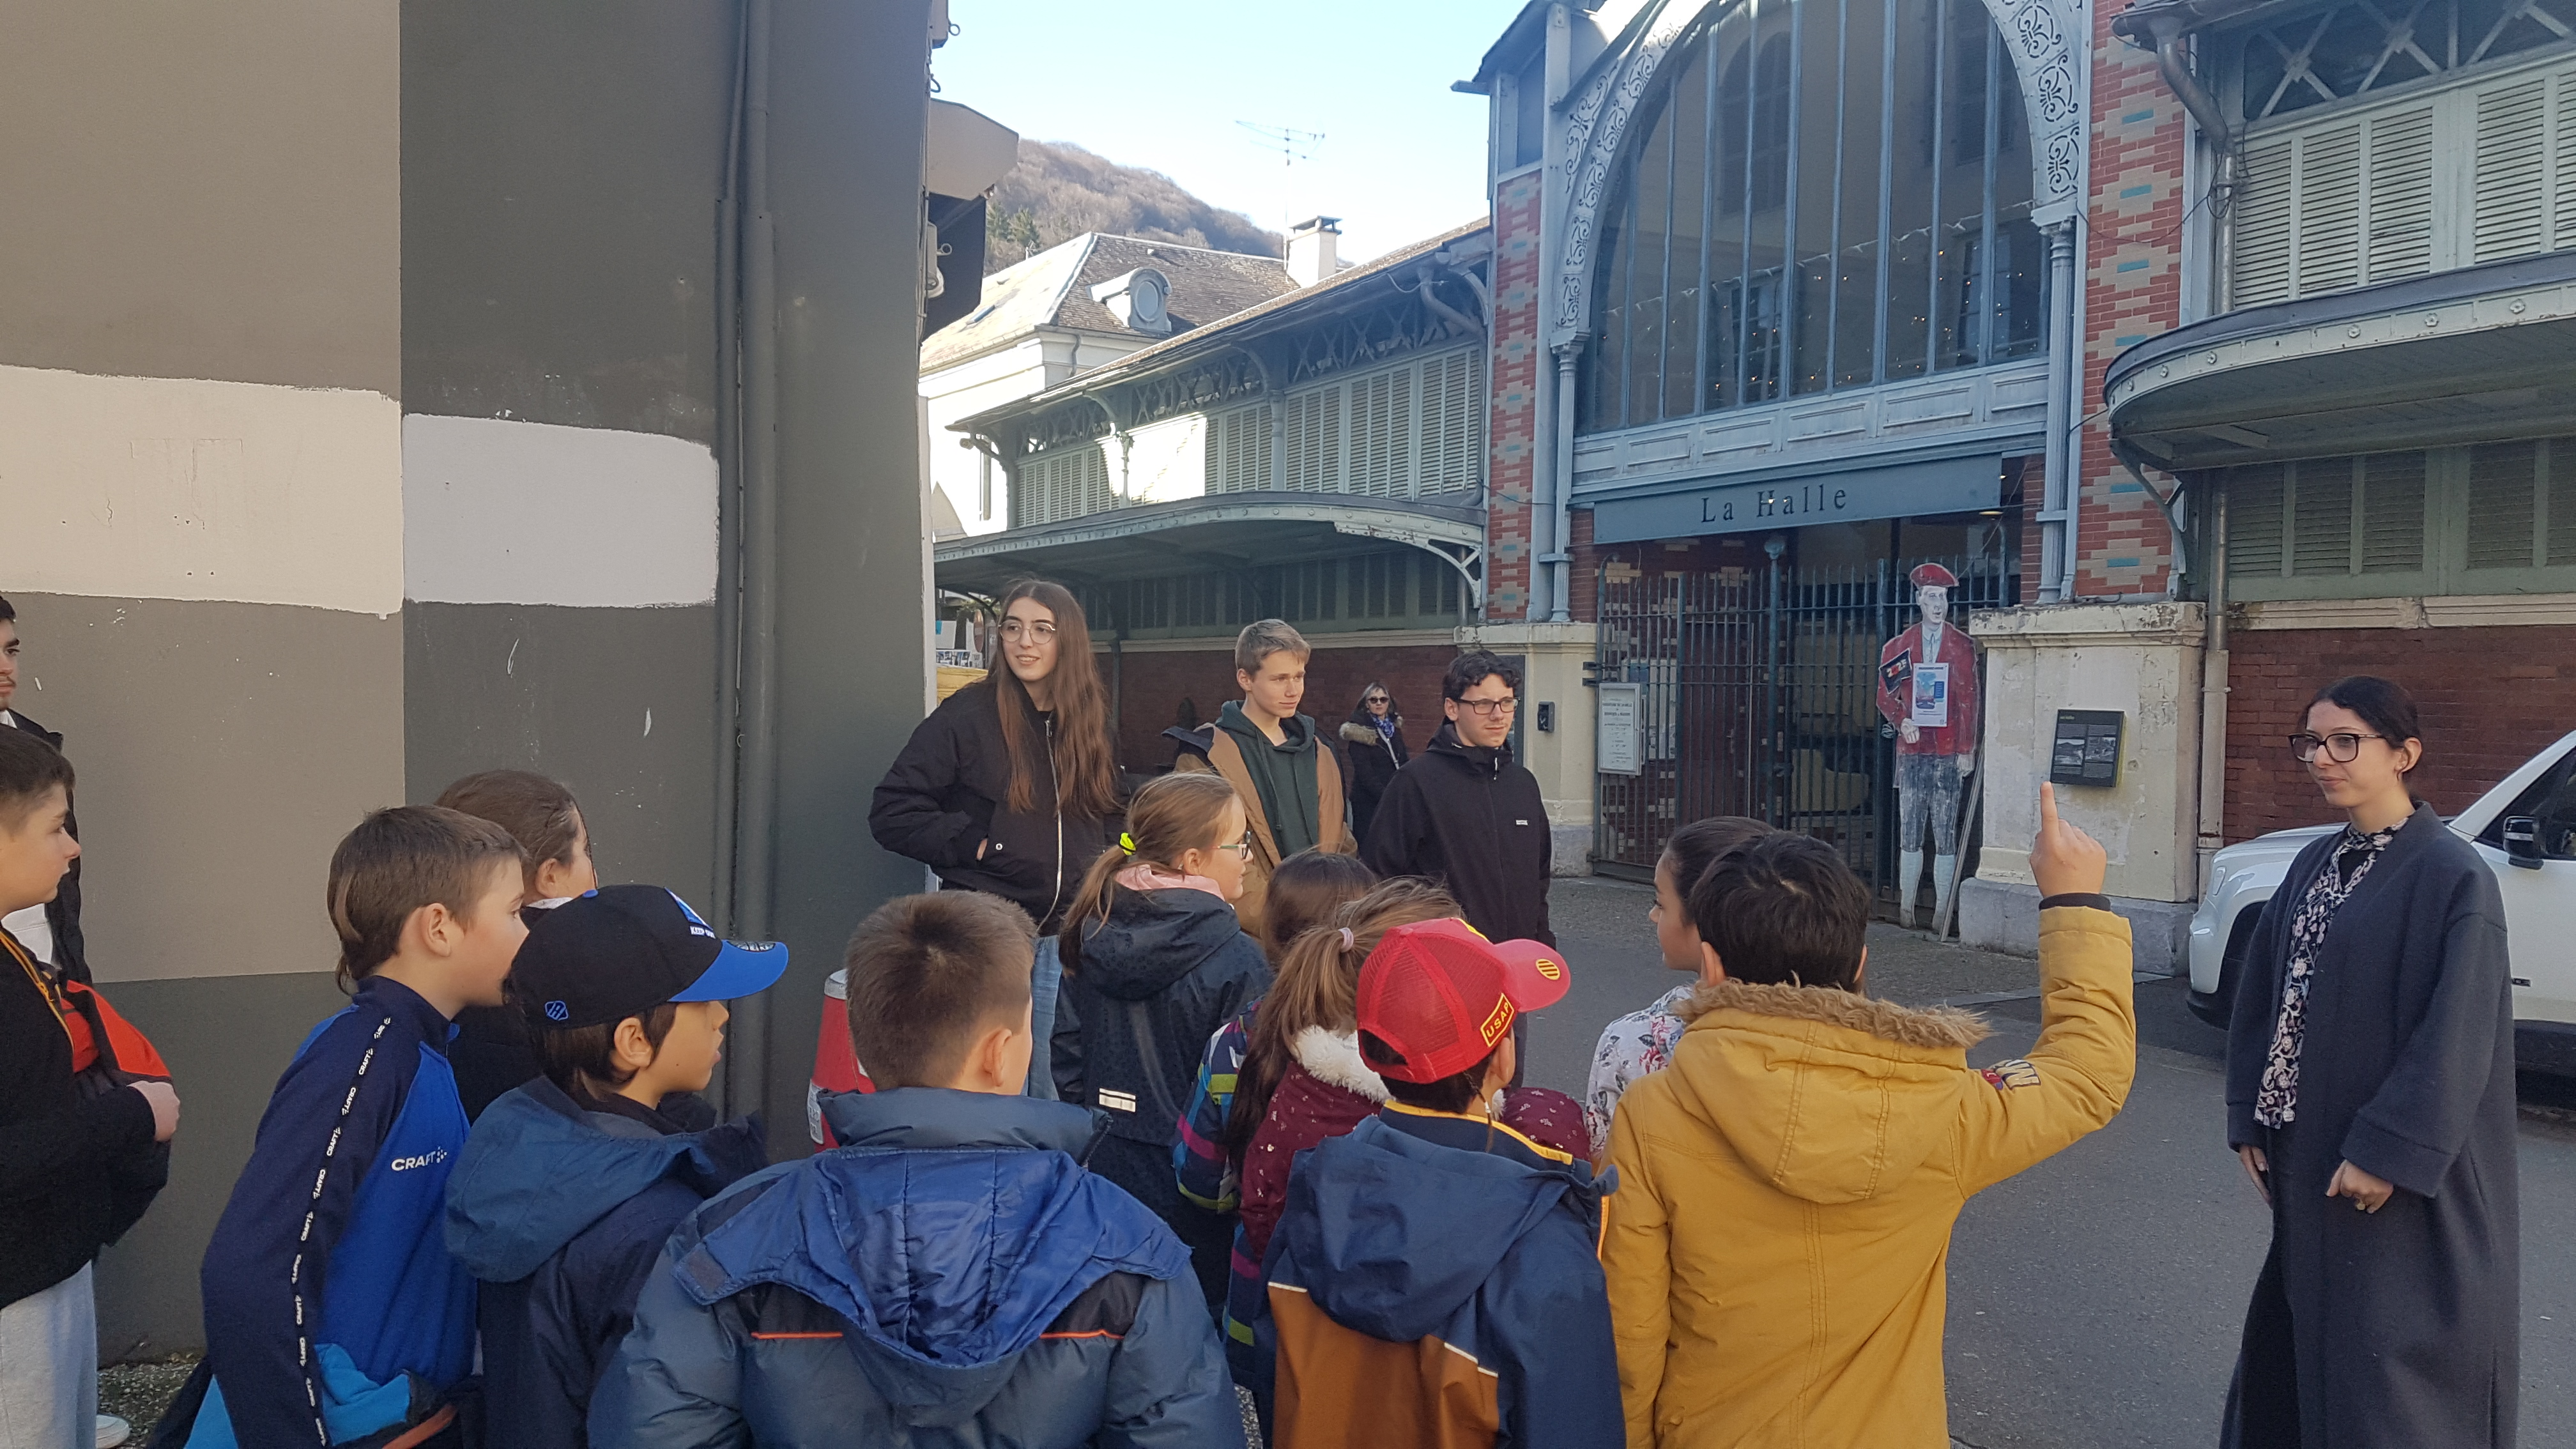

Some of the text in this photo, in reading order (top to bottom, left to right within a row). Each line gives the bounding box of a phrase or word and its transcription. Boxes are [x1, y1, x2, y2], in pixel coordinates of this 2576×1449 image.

[1701, 483, 1846, 523] La Halle
[1486, 1001, 1509, 1038] USAP
[358, 1053, 371, 1075] CRAFT
[344, 1087, 356, 1112] CRAFT
[326, 1133, 339, 1156] CRAFT
[391, 1151, 436, 1171] CRAFT
[315, 1169, 326, 1193] CRAFT
